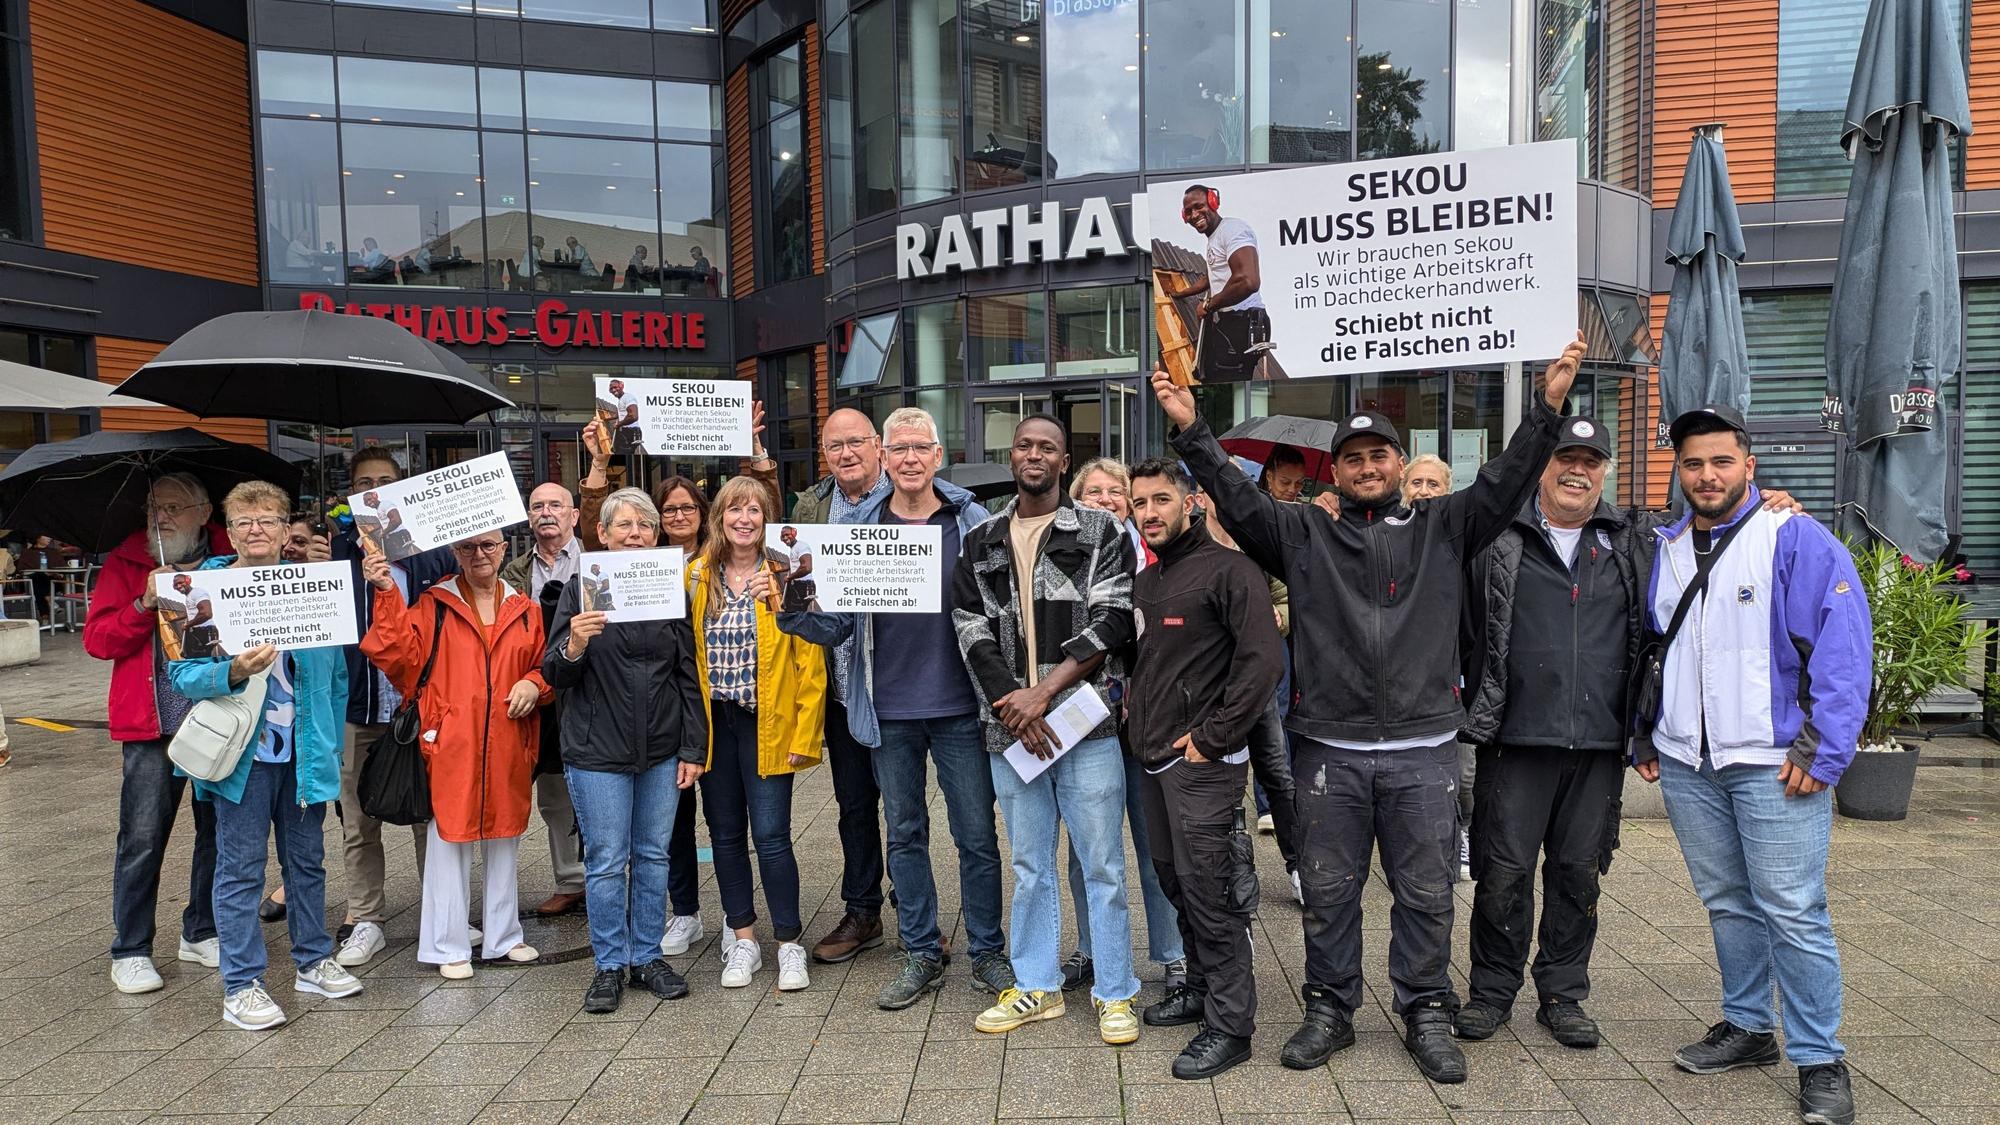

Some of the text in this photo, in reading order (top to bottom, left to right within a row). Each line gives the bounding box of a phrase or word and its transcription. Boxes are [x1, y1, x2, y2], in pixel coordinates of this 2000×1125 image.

[1348, 162, 1467, 202] SEKOU
[1280, 192, 1553, 246] MUSS BLEIBEN!
[1318, 236, 1513, 267] Wir brauchen Sekou
[1294, 252, 1534, 290] als wichtige Arbeitskraft
[1295, 273, 1540, 309] im Dachdeckerhandwerk.
[1335, 305, 1492, 336] Schiebt nicht
[1321, 330, 1516, 362] die Falschen ab!
[673, 383, 715, 393] SEKOU
[646, 396, 744, 408] MUSS BLEIBEN!
[426, 464, 470, 485] SEKOU
[404, 468, 505, 506] MUSS BLEIBEN!
[437, 492, 470, 505] brauchen
[472, 484, 494, 494] Sekou
[416, 489, 504, 520] als wichtige Arbeitskraft
[433, 515, 506, 542] die Falschen ab!
[436, 509, 495, 532] Schiebt nicht
[851, 529, 899, 540] SEKOU
[821, 544, 932, 556] MUSS BLEIBEN!
[252, 567, 306, 582] SEKOU
[640, 569, 678, 577] BLEIBEN!
[221, 579, 344, 600] MUSS BLEIBEN!
[844, 587, 880, 595] Schiebt
[245, 607, 281, 616] wichtige
[285, 602, 337, 613] Arbeitskraft
[259, 597, 299, 607] brauchen
[302, 595, 328, 603] Sekou
[837, 598, 852, 606] die
[902, 598, 917, 607] ab!
[244, 611, 341, 625] Dachdeckerhandwerk.
[244, 632, 332, 648] die Falschen ab!
[250, 623, 321, 636] Schiebt nicht
